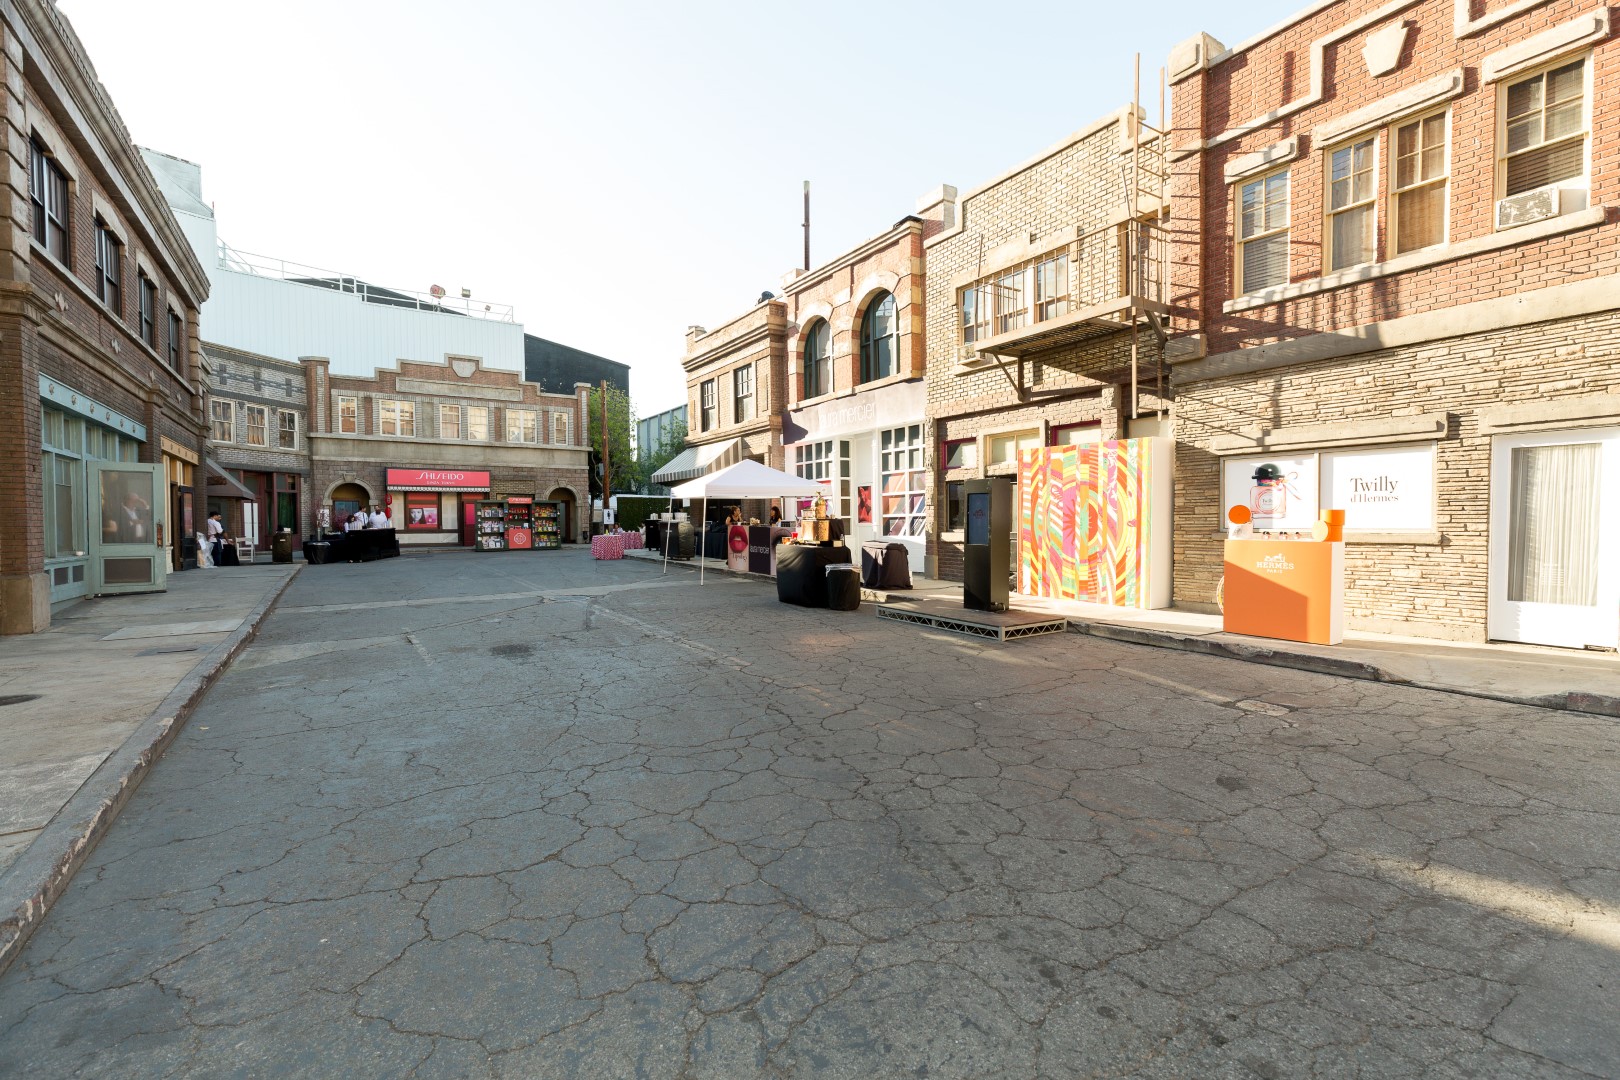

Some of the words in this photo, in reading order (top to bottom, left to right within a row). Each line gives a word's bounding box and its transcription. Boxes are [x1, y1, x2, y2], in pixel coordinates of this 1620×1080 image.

[818, 405, 838, 426] laura
[839, 403, 875, 425] mercier
[416, 471, 464, 480] SHISEIDO
[1350, 475, 1398, 493] Twilly
